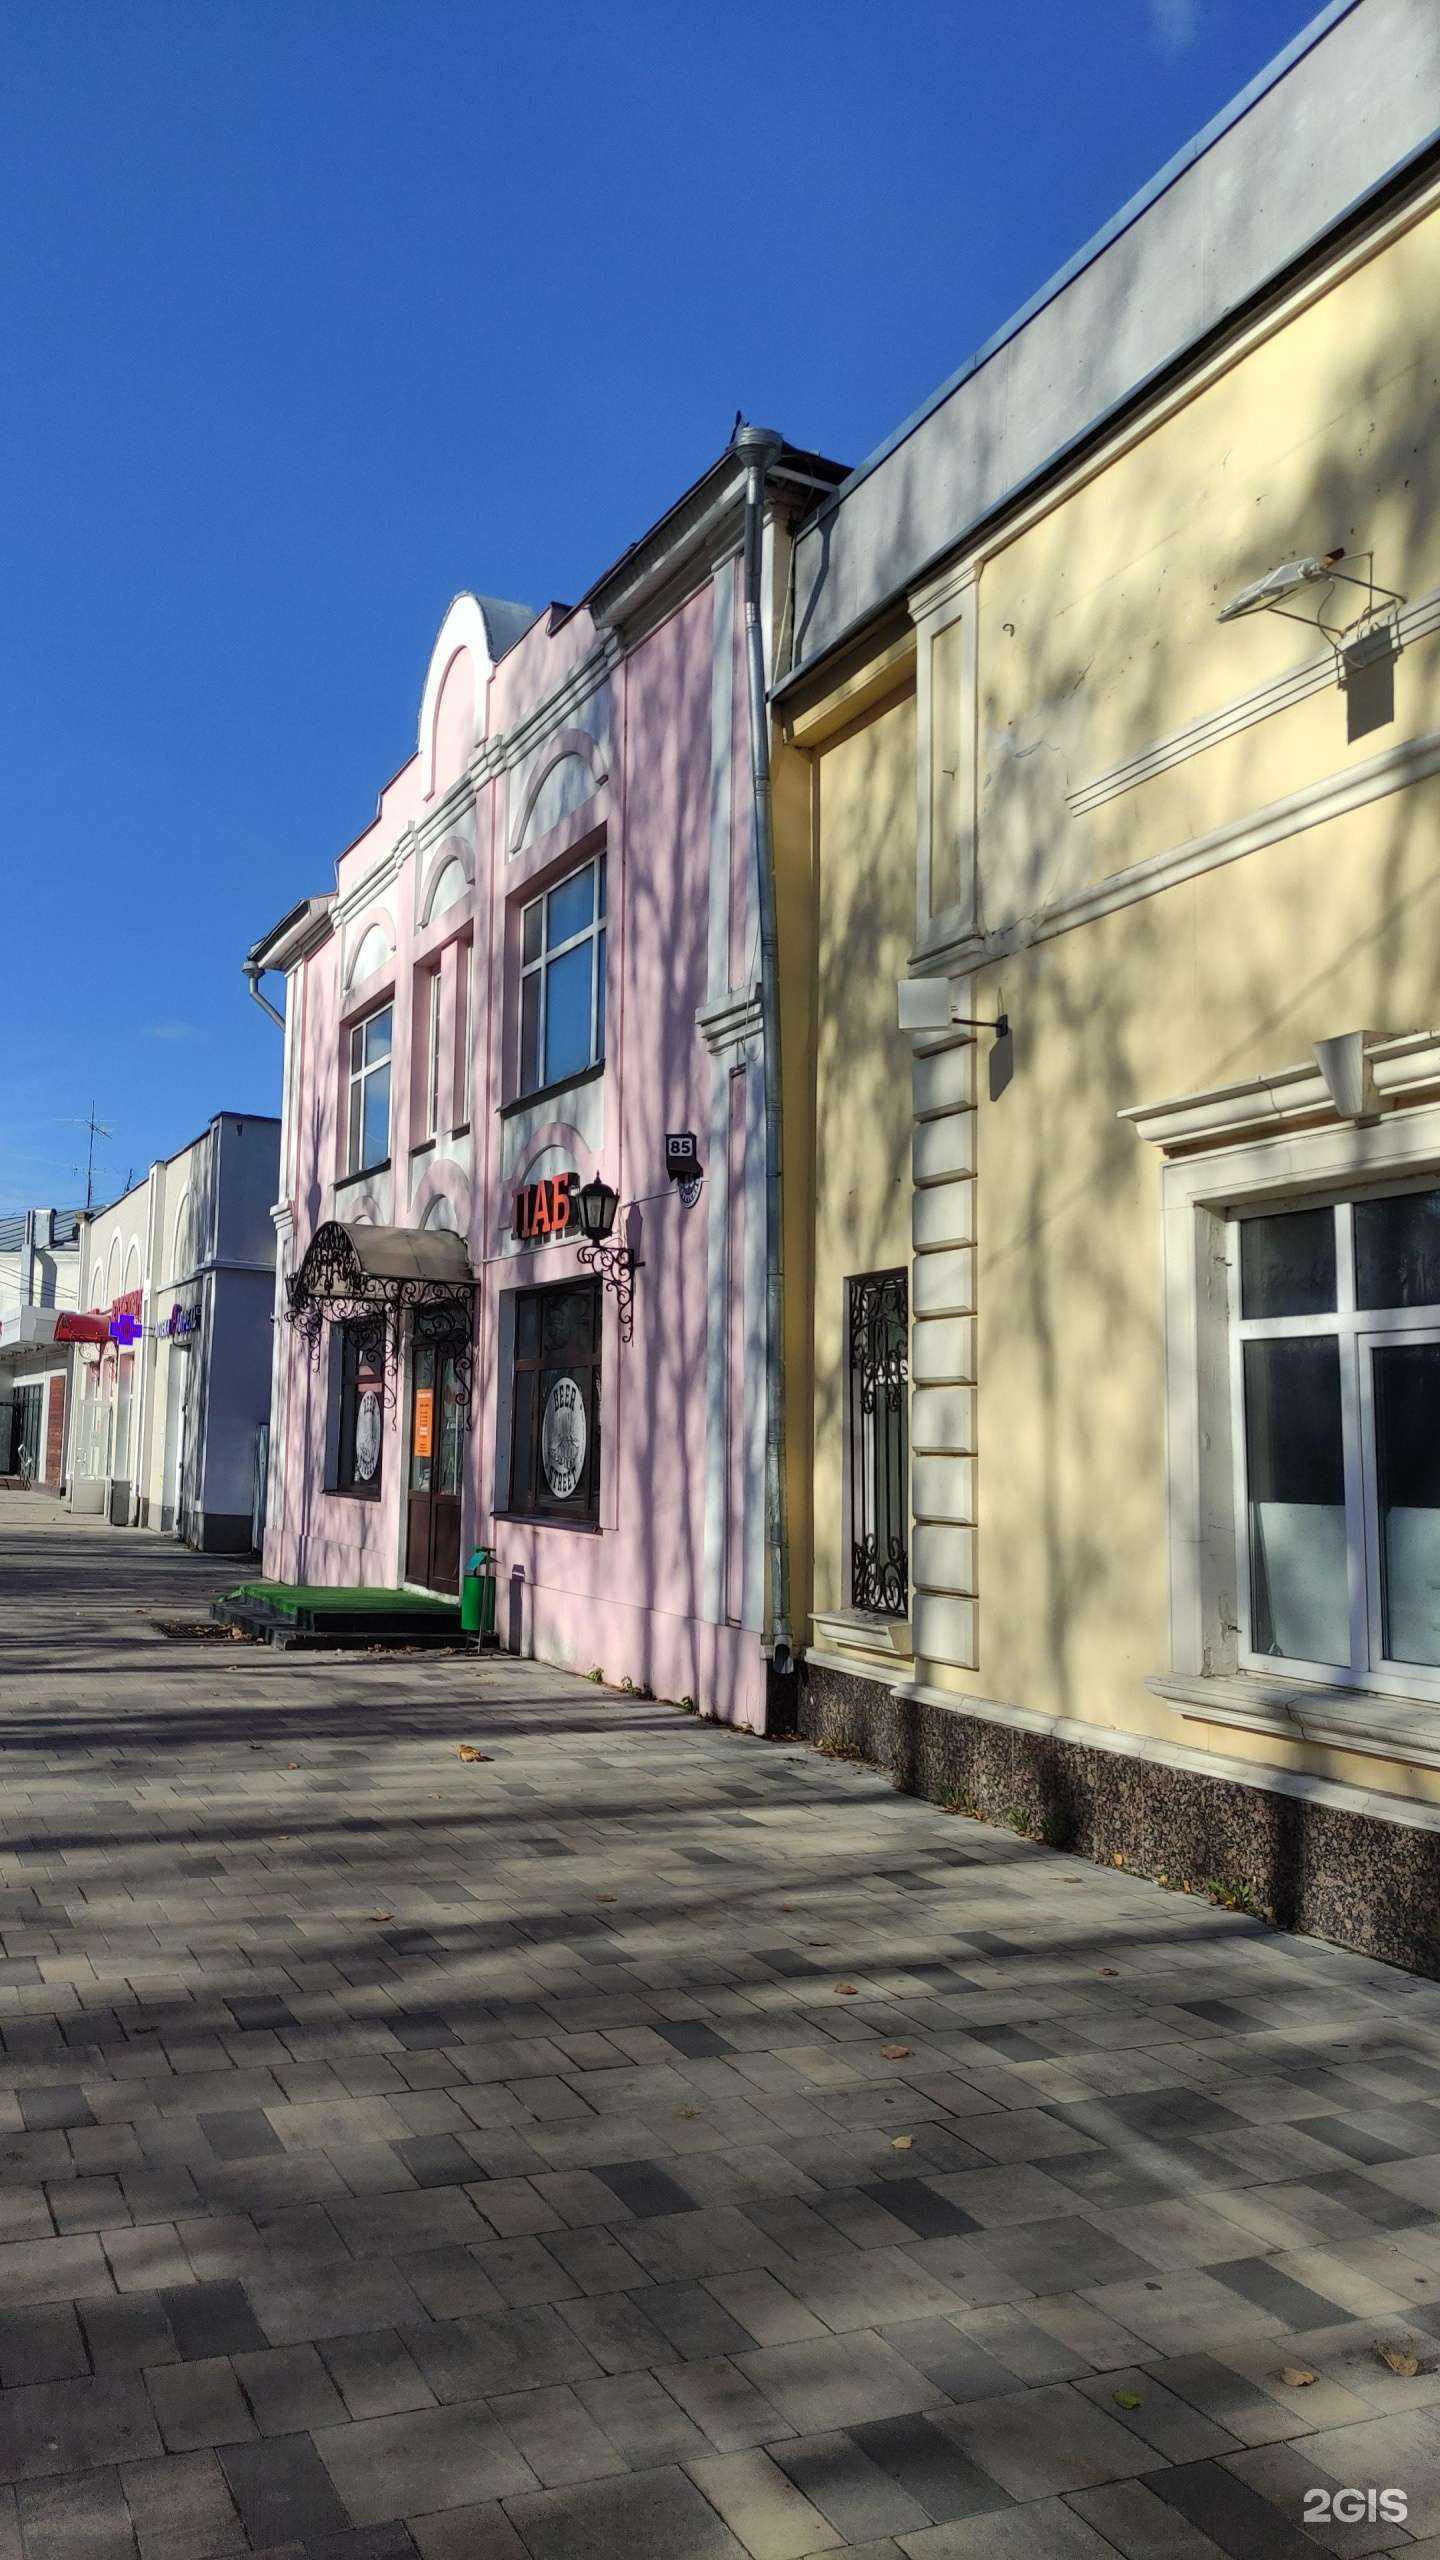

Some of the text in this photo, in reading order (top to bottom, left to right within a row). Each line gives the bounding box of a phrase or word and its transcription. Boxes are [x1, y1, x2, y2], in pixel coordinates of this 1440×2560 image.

[670, 1140, 691, 1154] 85
[511, 1171, 570, 1240] ПАБ
[553, 1384, 577, 1411] BEER
[548, 1466, 577, 1492] STREET
